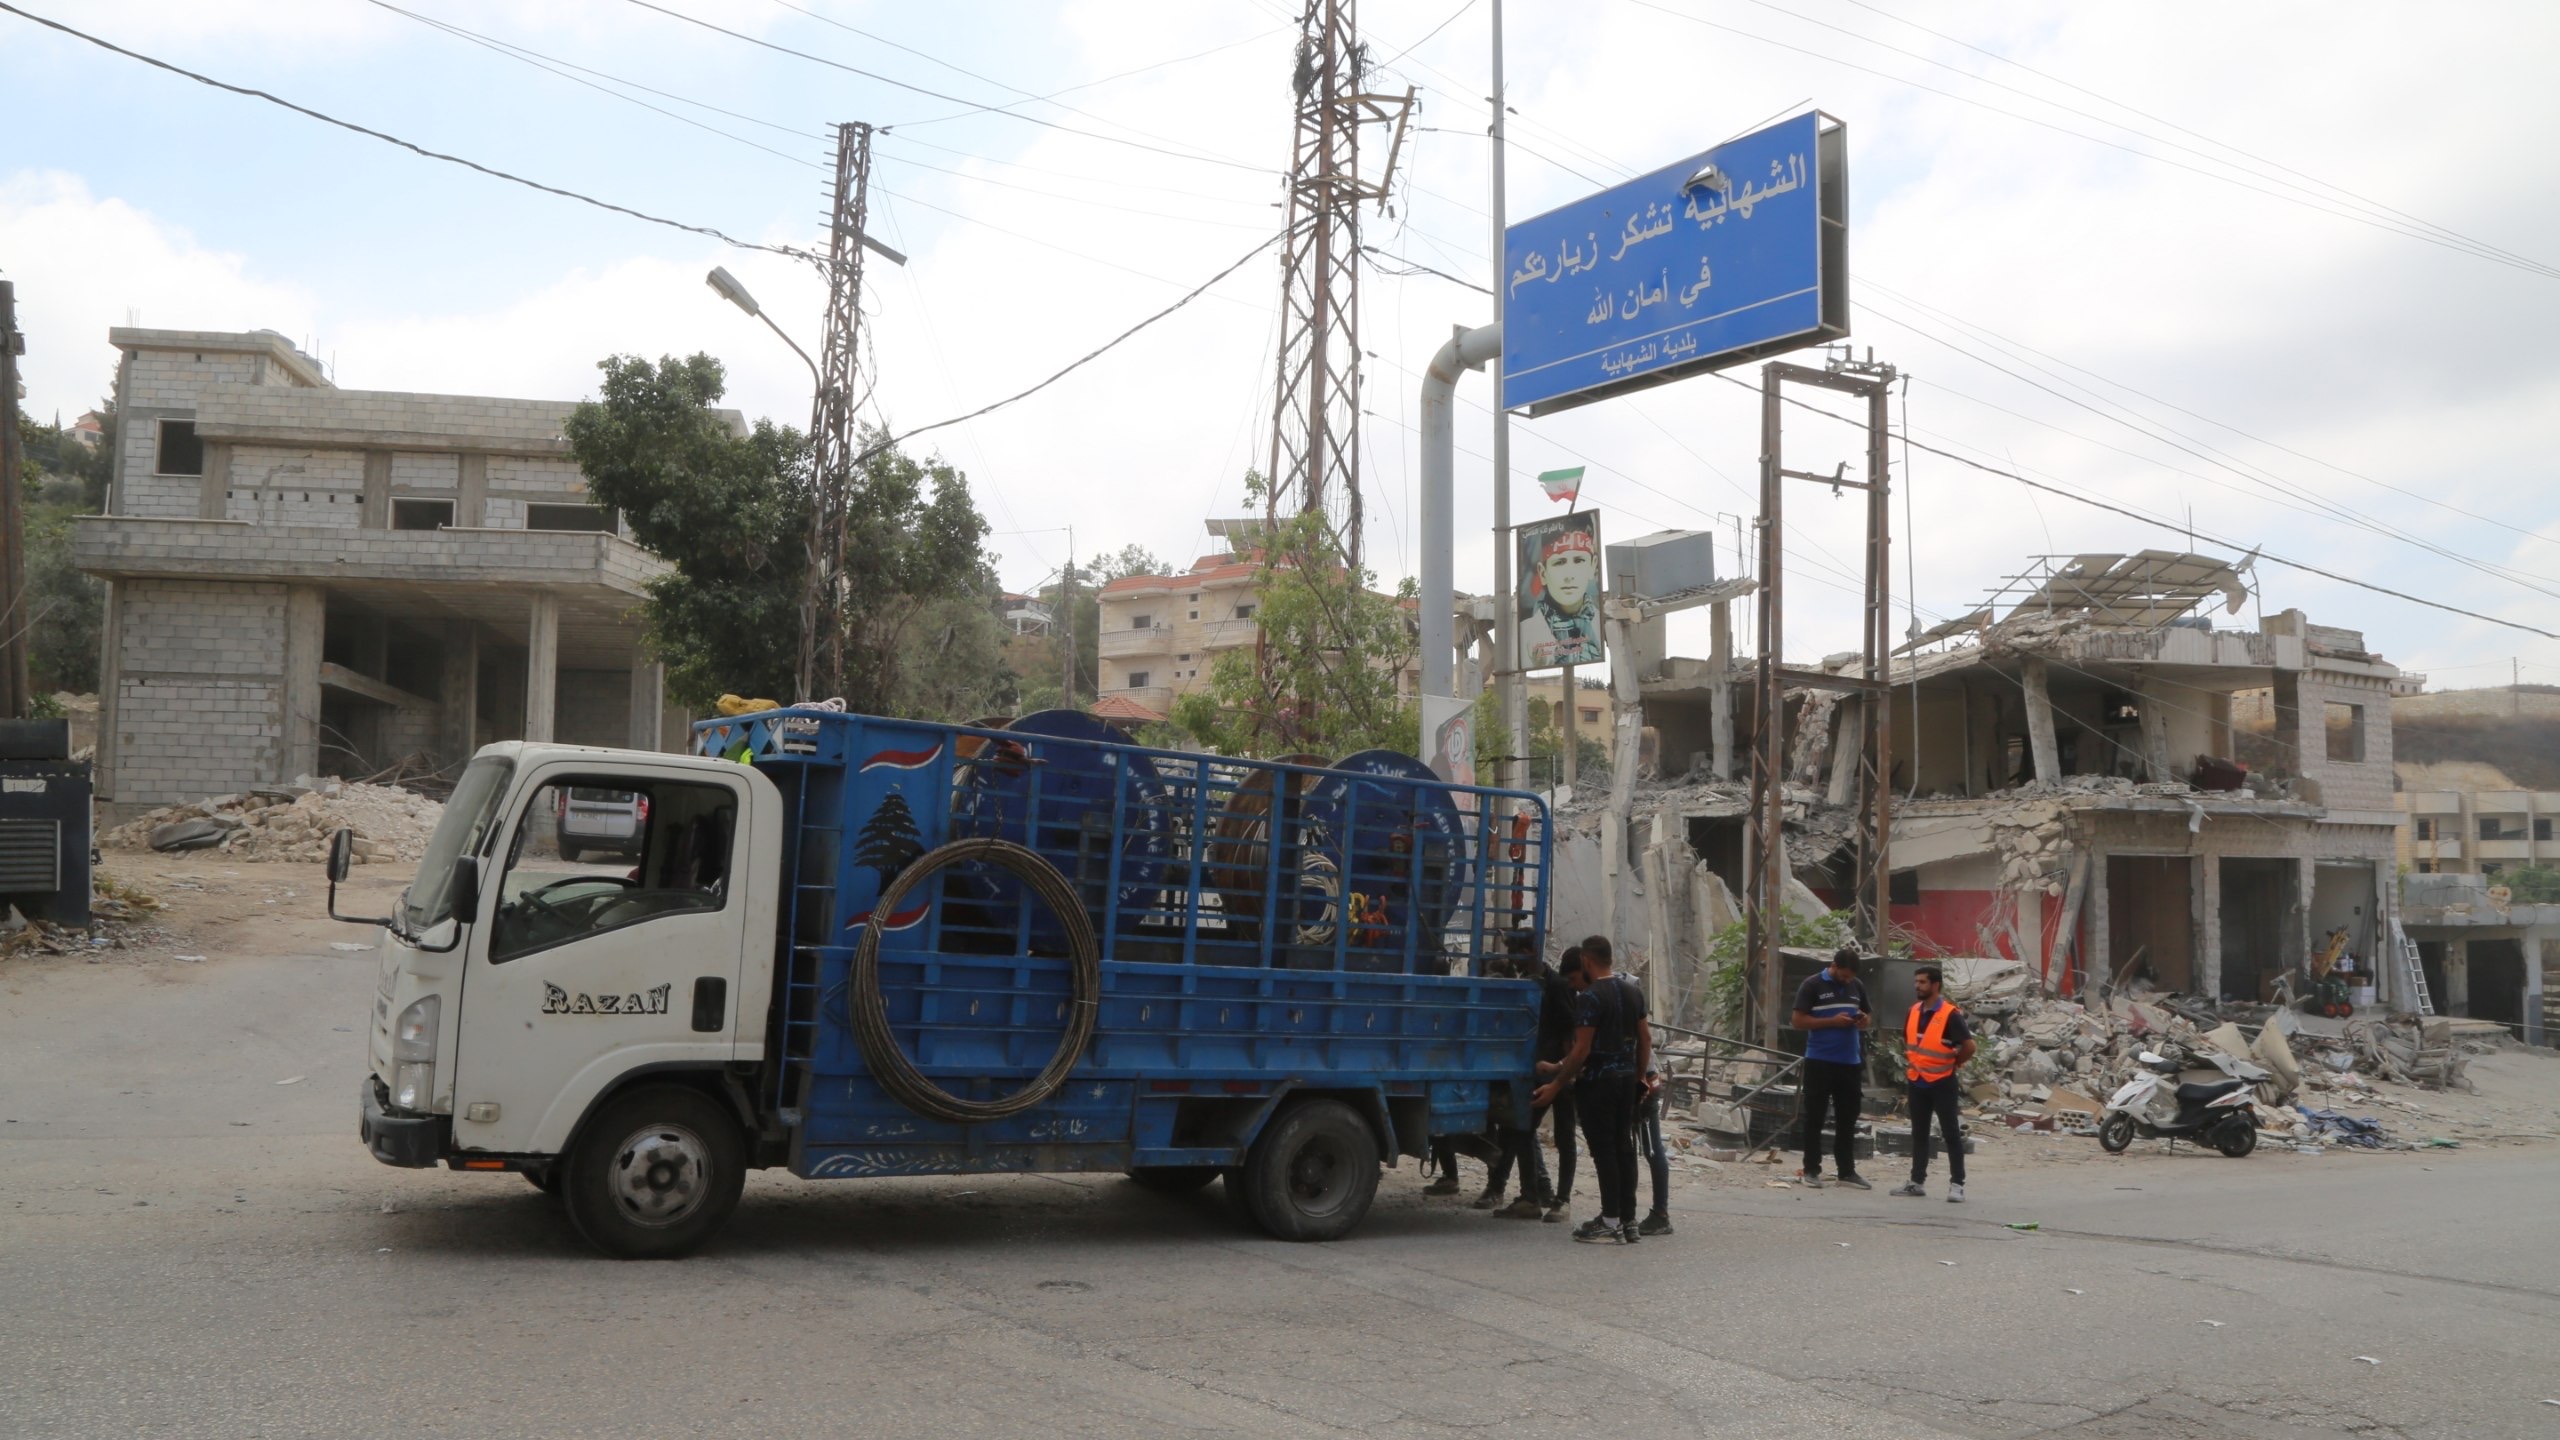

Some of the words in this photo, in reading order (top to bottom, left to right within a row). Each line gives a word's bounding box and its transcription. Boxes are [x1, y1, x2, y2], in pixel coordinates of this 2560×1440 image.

[1683, 152, 1806, 230] الشهابية
[1610, 202, 1673, 260] تشكر
[1510, 232, 1597, 300] زيارتكم
[1680, 256, 1711, 309] في
[1586, 286, 1613, 325] الله
[1622, 267, 1668, 320] أمان
[1601, 343, 1657, 376] الشهابية
[1663, 332, 1697, 360] بلدية
[541, 980, 672, 1014] RAZAN
